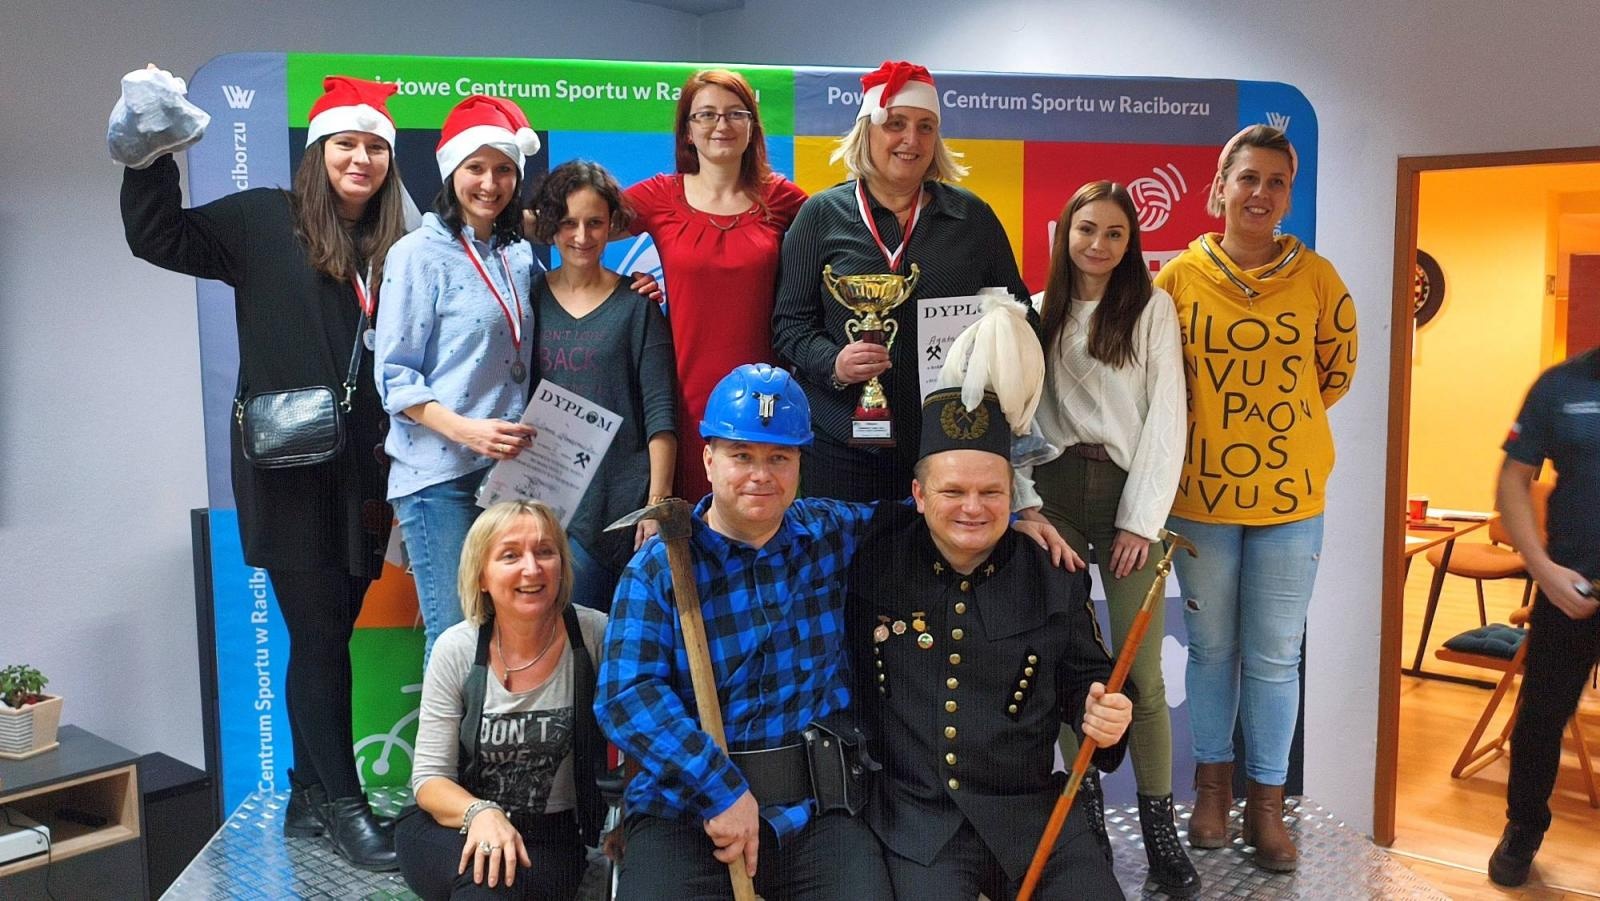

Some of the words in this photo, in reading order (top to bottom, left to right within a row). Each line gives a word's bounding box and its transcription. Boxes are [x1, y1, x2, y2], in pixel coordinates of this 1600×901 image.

[455, 77, 551, 98] Centrum
[555, 79, 627, 101] Sportu
[633, 86, 651, 100] w
[943, 89, 1027, 110] Centrum
[1031, 92, 1094, 114] Sportu
[1099, 99, 1115, 113] w
[1119, 95, 1210, 116] Raciborzu
[924, 303, 983, 319] DYPL
[248, 567, 268, 624] Racib
[255, 627, 269, 645] w
[254, 648, 275, 711] Sportu
[480, 713, 551, 746] DON'T
[257, 714, 275, 793] Centrum
